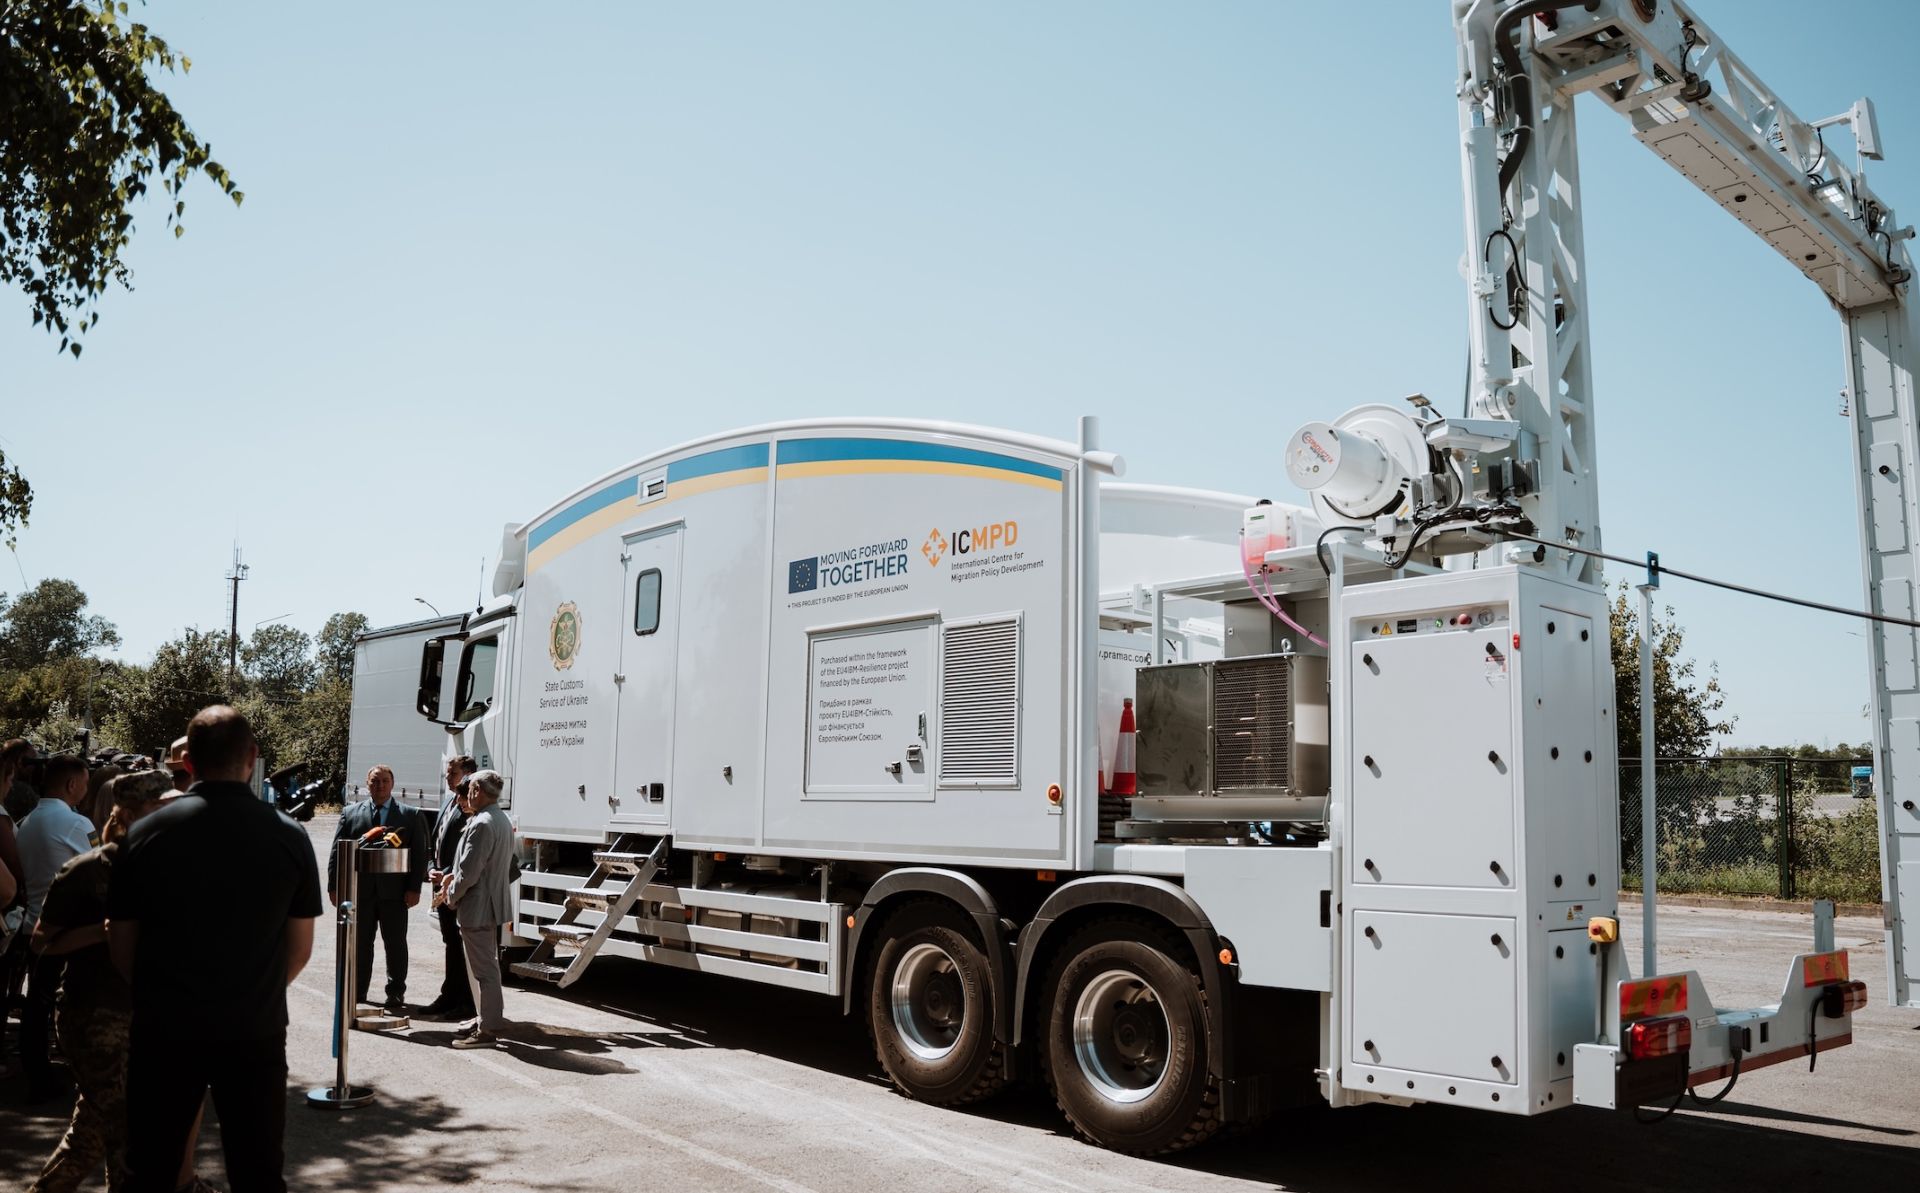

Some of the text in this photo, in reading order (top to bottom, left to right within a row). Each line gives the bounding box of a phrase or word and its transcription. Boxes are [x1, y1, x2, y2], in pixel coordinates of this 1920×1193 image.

[951, 520, 1018, 556] ICMPD
[820, 538, 908, 567] MOVING FORWARD
[951, 551, 1024, 570] International Centre for
[820, 554, 908, 588] TOGETHER
[951, 560, 1044, 583] Migration Policy Development
[802, 598, 821, 607] PROJECT
[827, 594, 846, 603] FUNDED
[854, 590, 863, 598] THE
[863, 587, 891, 597] EUROPEAN
[891, 584, 909, 593] UNION
[820, 648, 907, 665] Purchased within the framework
[826, 667, 836, 676] the
[888, 660, 909, 672] project
[545, 679, 584, 691] State Customs
[820, 678, 843, 688] financed
[850, 677, 860, 685] the
[860, 675, 888, 685] European
[540, 697, 559, 708] Service
[567, 694, 588, 705] Ukraine
[819, 699, 847, 708] Придбано
[852, 699, 872, 707] рамках
[540, 720, 587, 732] Державна митна
[540, 734, 585, 749] служба України
